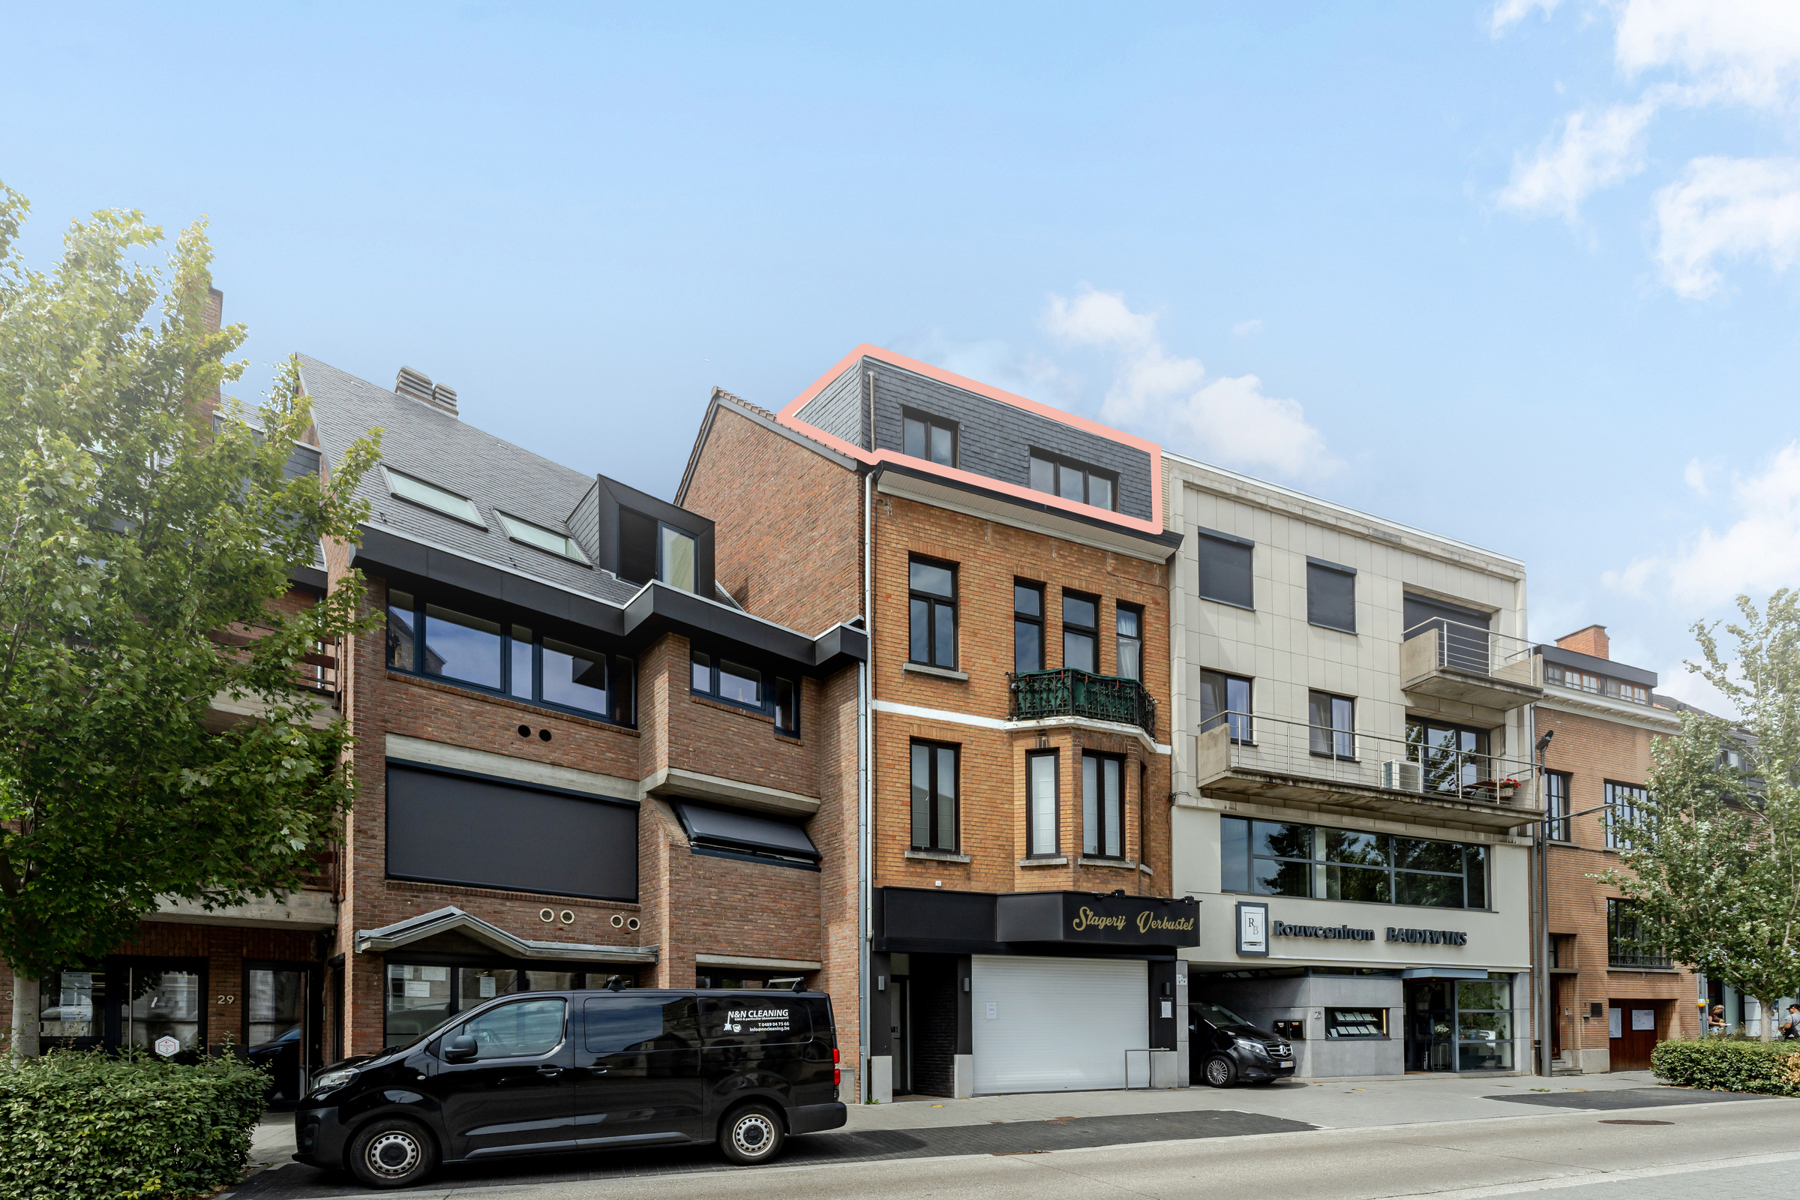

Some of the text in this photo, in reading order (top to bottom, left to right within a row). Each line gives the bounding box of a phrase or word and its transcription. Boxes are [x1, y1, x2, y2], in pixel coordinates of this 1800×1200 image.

[1073, 906, 1194, 933] Slagerij Verbustel
[1273, 920, 1467, 946] Rouwcentrum BAUDEWYNS
[217, 994, 235, 1005] 29
[748, 1009, 788, 1018] CLEANING
